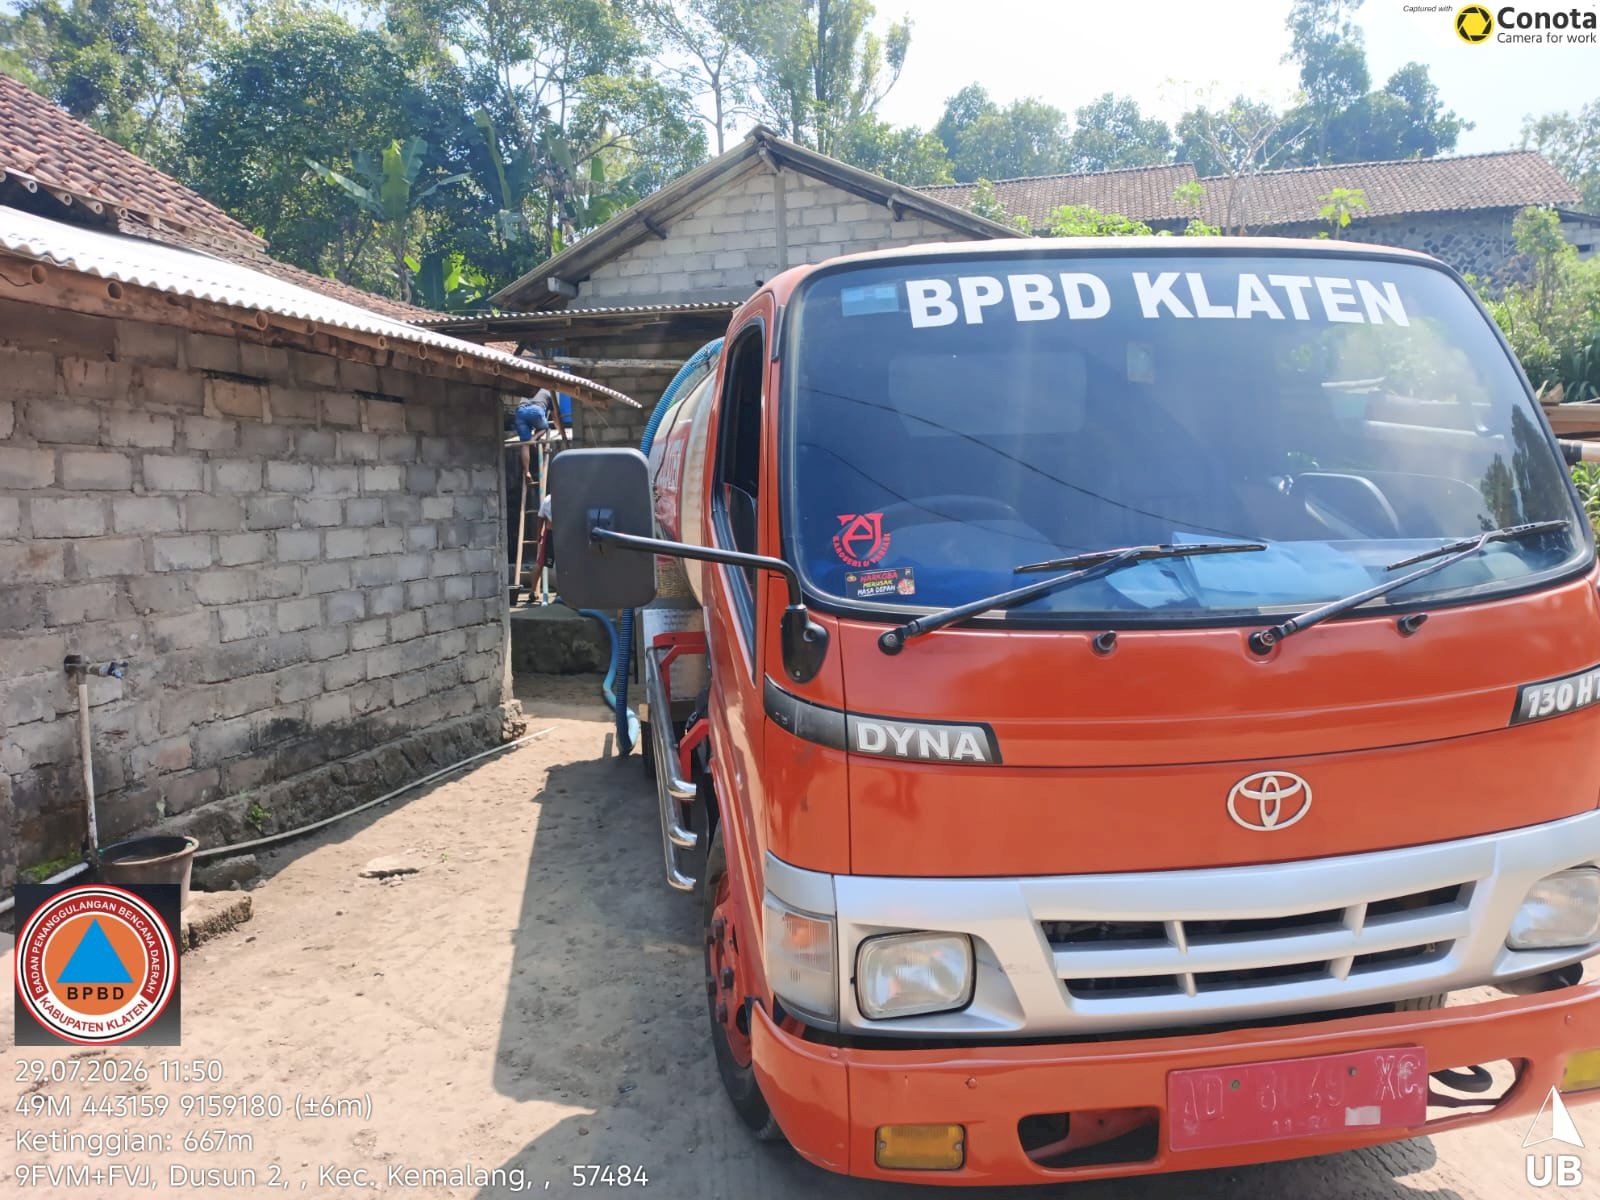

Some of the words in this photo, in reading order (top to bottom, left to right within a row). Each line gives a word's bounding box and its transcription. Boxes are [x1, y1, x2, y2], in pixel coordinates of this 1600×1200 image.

[905, 272, 1112, 329] BPBD
[1131, 271, 1411, 327] KLATEN
[857, 588, 875, 596] MASA
[859, 571, 898, 583] NARKOBA
[1528, 683, 1574, 718] 130
[856, 722, 986, 762] DYNA
